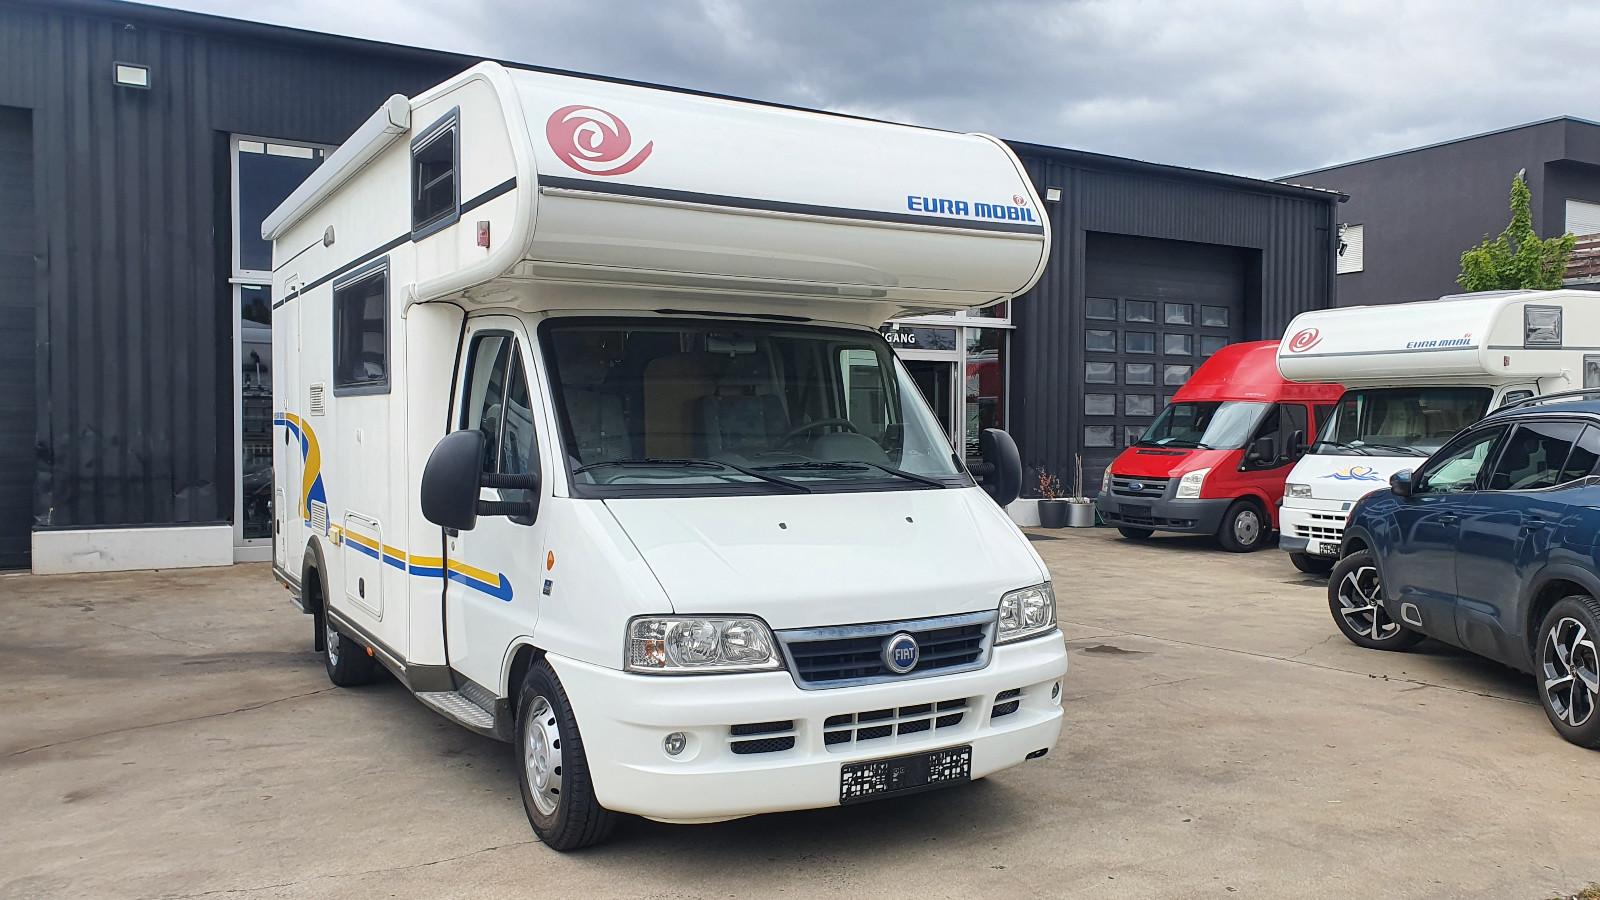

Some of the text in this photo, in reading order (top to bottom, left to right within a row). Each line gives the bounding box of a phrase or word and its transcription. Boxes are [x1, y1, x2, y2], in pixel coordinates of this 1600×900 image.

[907, 195, 1036, 222] EURA MOBIL
[895, 647, 915, 661] FIAT
